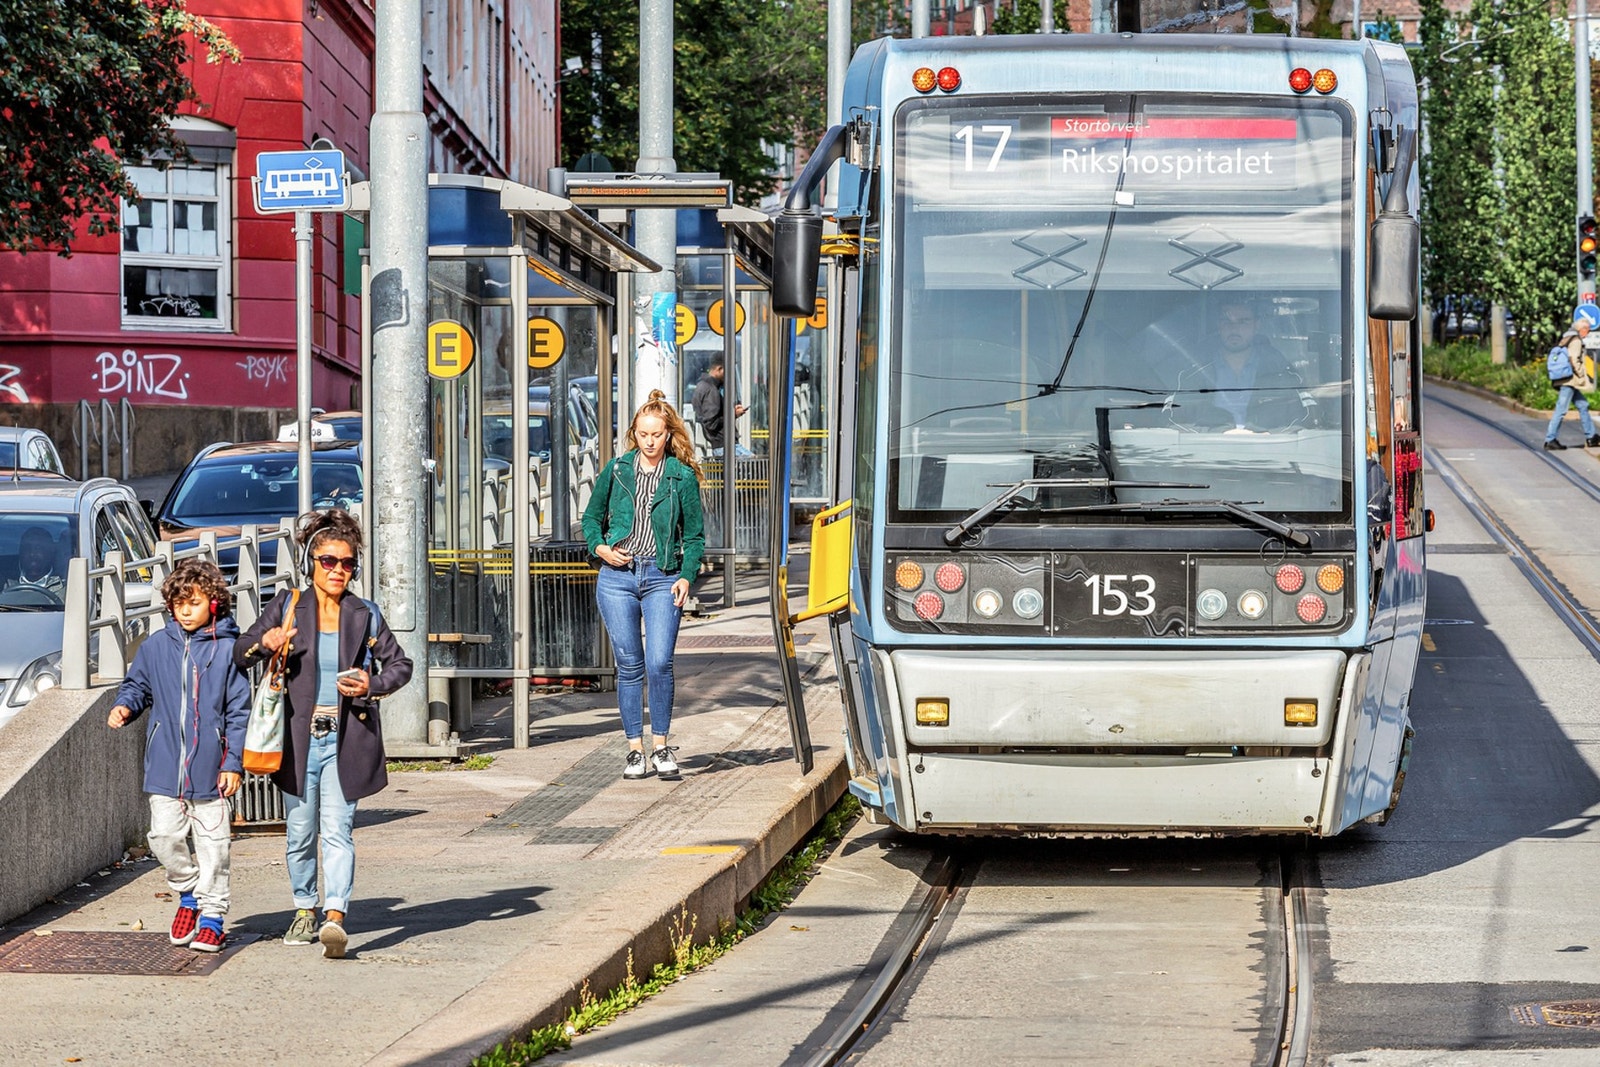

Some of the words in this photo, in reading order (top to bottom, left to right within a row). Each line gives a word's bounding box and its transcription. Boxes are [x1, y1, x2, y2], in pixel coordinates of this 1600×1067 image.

[1063, 118, 1141, 133] Stortorvet
[955, 125, 1012, 172] 17
[1061, 147, 1274, 181] Rikshospitalet
[435, 332, 458, 367] E
[529, 328, 550, 358] E
[1083, 574, 1156, 616] 153
